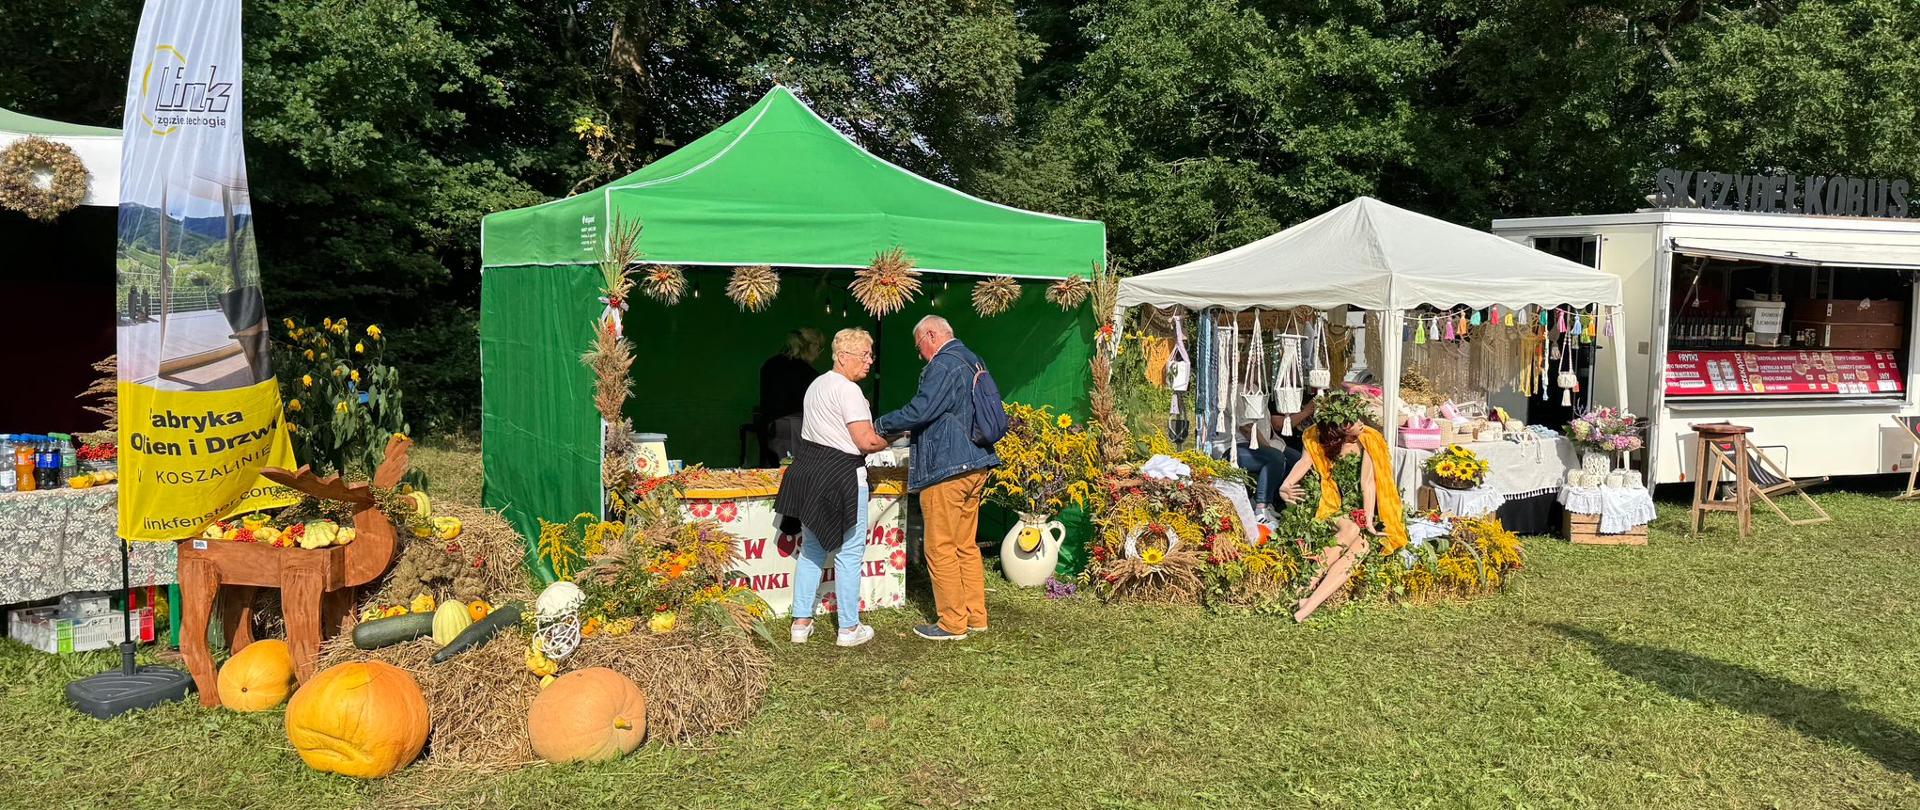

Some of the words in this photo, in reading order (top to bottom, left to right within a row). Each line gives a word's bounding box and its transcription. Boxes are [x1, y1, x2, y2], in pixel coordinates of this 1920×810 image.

[131, 432, 182, 455] Oien
[188, 438, 198, 455] i
[206, 416, 277, 454] Drzwi
[150, 408, 244, 433] abryka
[156, 444, 271, 485] KOSZALINIE
[743, 538, 768, 560] W
